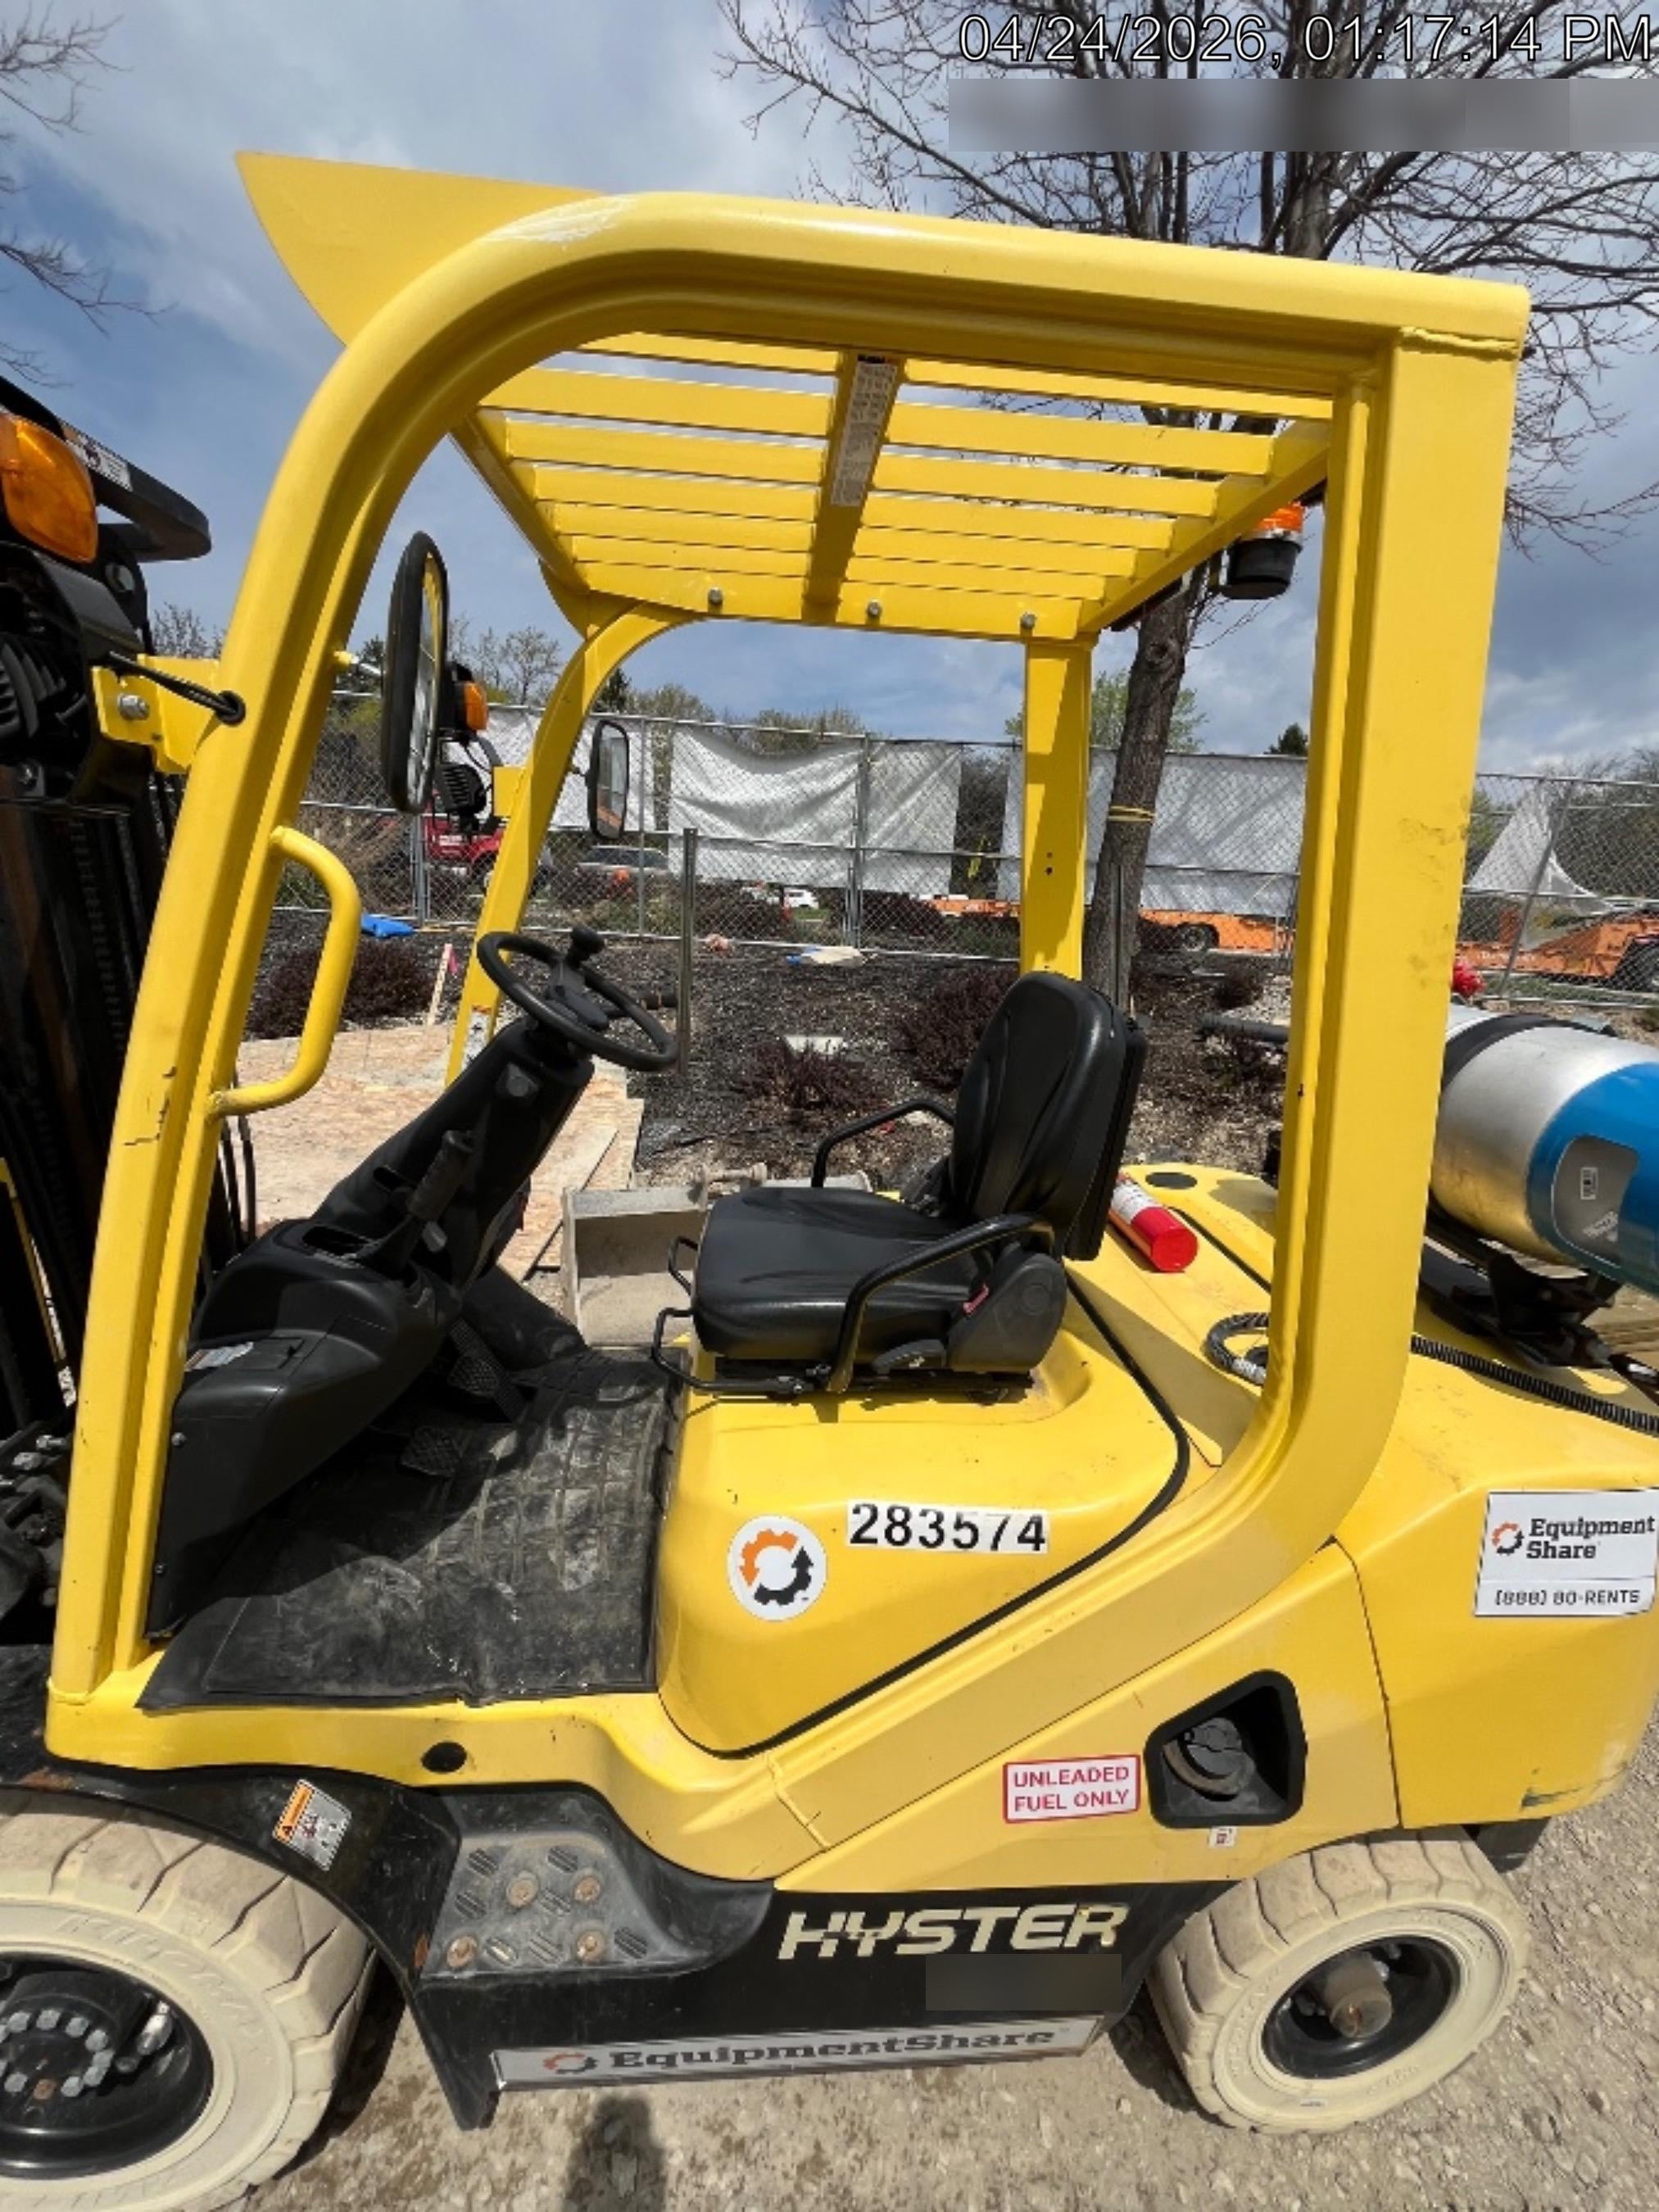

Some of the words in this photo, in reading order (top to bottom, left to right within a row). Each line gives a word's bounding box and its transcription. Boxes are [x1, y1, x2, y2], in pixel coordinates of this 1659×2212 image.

[850, 1503, 1046, 1552] 283574
[1528, 1516, 1655, 1541] Equipment
[1526, 1540, 1596, 1559] Share
[1013, 1766, 1129, 1788] UNLEADED
[1014, 1793, 1067, 1812] FUEL
[1073, 1788, 1129, 1807] ONLY
[777, 1903, 1129, 1960] HYSTER
[611, 2031, 1055, 2070] EquipmentShare
